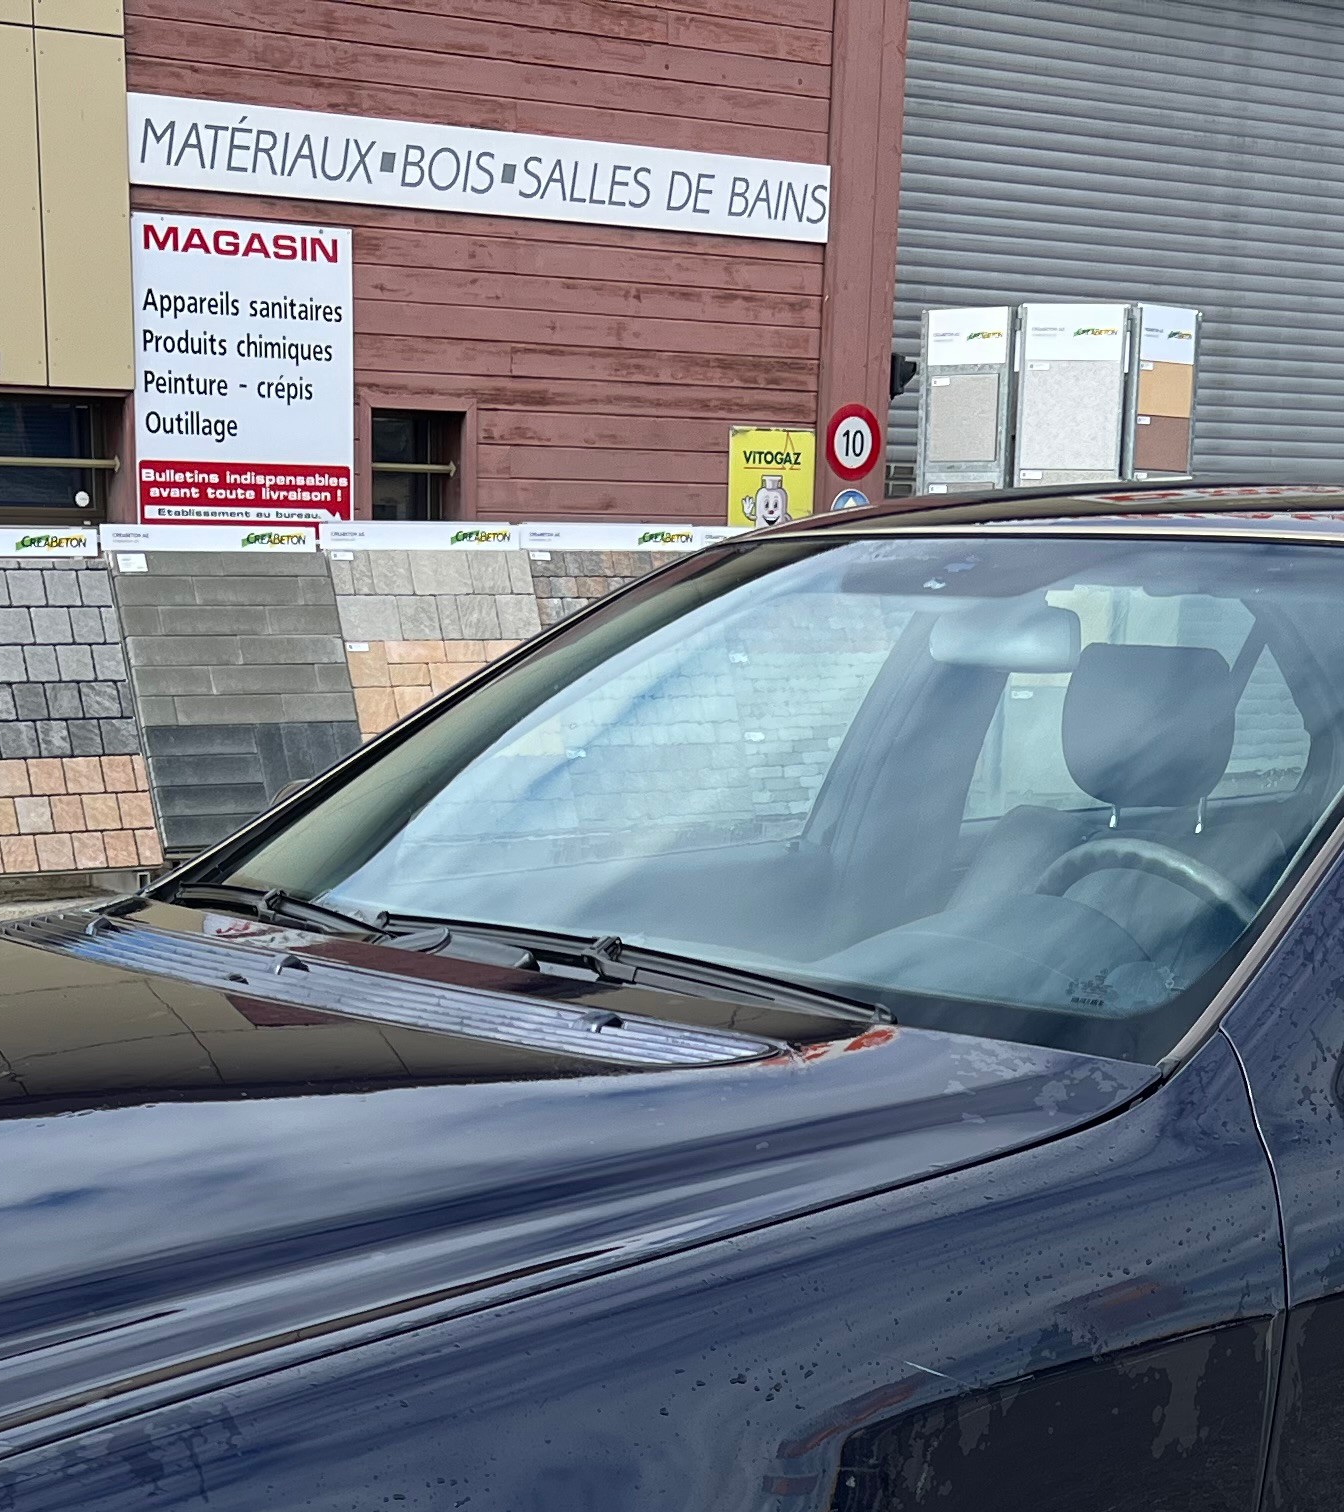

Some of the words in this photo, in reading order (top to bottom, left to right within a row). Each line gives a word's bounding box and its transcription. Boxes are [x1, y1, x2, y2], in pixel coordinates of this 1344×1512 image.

[140, 115, 377, 184] MATÉRIAUX
[401, 144, 496, 195] BOIS
[518, 156, 652, 209] SALLES
[666, 170, 716, 214] DE
[727, 176, 828, 225] BAINS
[142, 223, 338, 264] MAGASIN
[142, 288, 240, 319] Appareils
[248, 295, 343, 323] sanitaires
[142, 329, 228, 356] Produits
[236, 333, 333, 366] chimiques
[143, 369, 229, 396] Peinture
[256, 375, 314, 405] crépis
[145, 411, 239, 443] Outillage
[742, 450, 802, 466] VITOGAZ
[842, 429, 865, 458] 10
[141, 468, 220, 484] Bulletins
[225, 471, 349, 488] indispensables
[149, 486, 200, 499] avant
[206, 486, 256, 500] toute
[261, 486, 331, 502] livraison
[336, 488, 343, 502] !
[157, 507, 251, 519] Etablissement
[255, 511, 271, 519] au
[275, 510, 322, 520] bureau.
